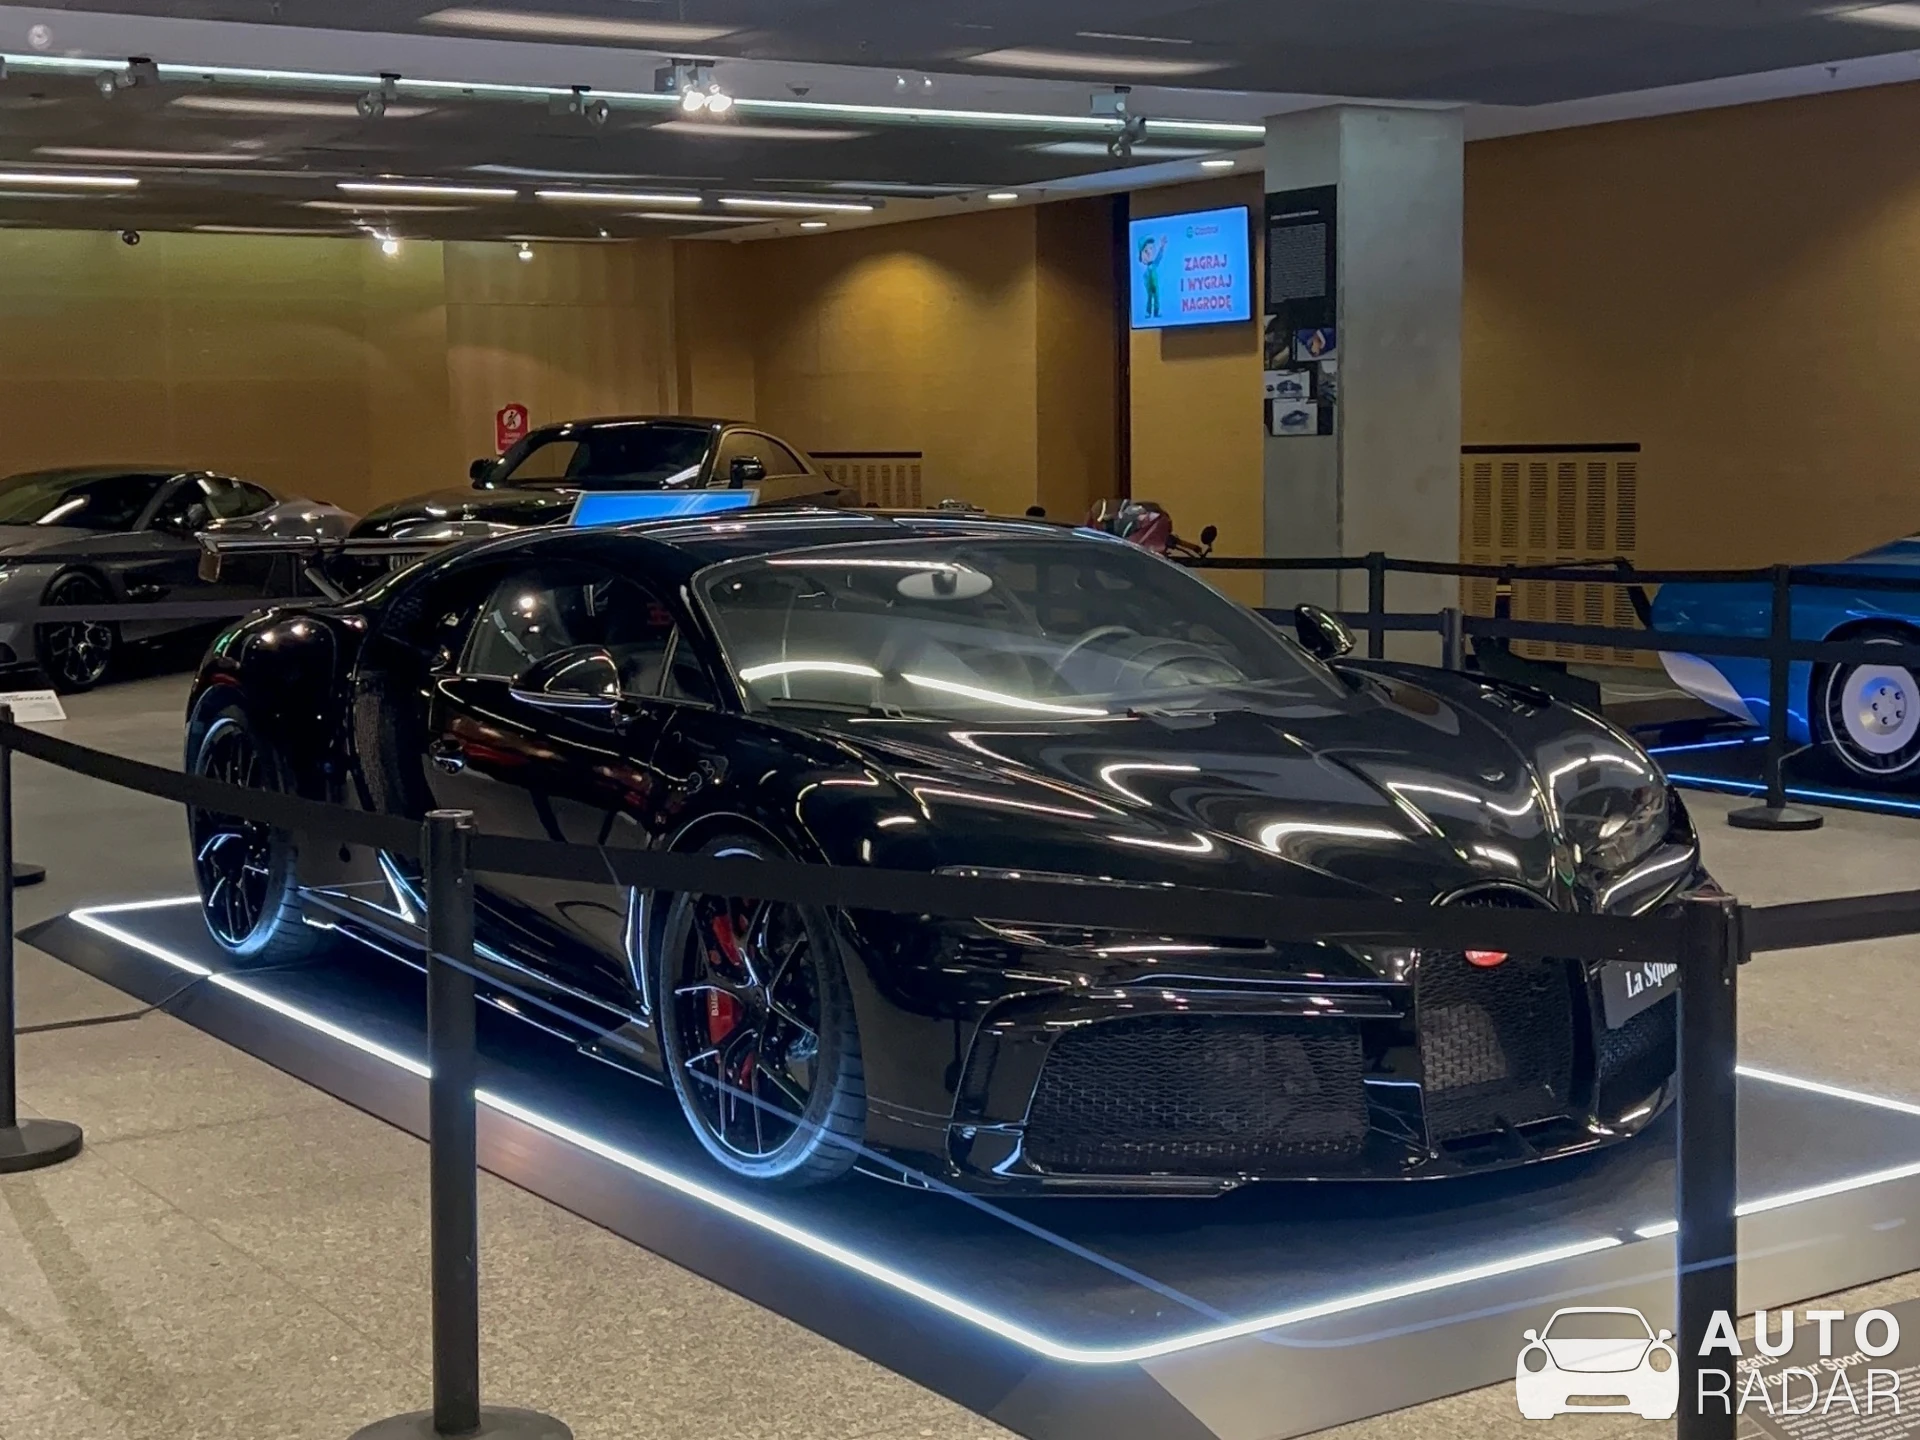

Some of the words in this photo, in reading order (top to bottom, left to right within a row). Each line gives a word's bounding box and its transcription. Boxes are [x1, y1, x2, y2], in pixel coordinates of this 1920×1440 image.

[1184, 254, 1227, 271] ZAGRAJ
[1187, 274, 1232, 291] WYGRAJ
[1182, 295, 1232, 312] NAGRODĘ
[1625, 970, 1644, 998] La
[1644, 961, 1678, 987] Squa
[1819, 1351, 1872, 1371] Sport
